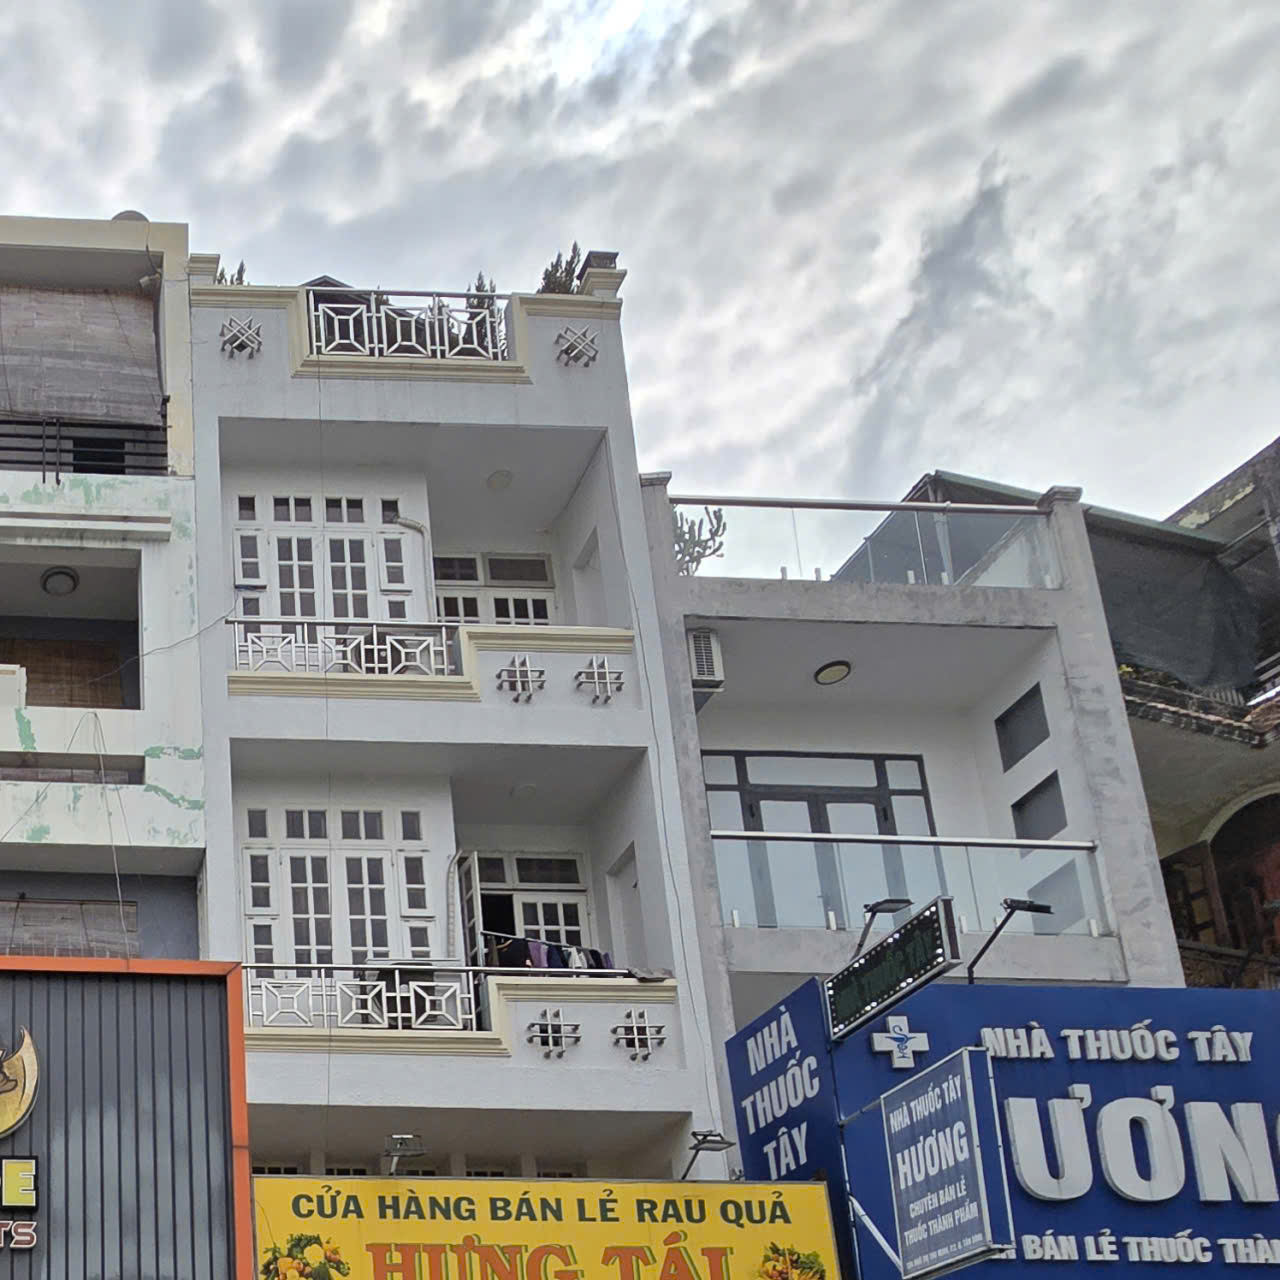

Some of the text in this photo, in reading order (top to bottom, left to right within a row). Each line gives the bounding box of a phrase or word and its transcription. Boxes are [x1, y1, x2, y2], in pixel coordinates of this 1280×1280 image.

[747, 1005, 799, 1076] NHÀ
[980, 1019, 1253, 1062] NHÀ THUỐC TÂY
[742, 1050, 820, 1135] THUỐC
[889, 1074, 962, 1134] NHÀ THUỐC TÂY
[763, 1121, 808, 1180] TÂY
[895, 1120, 970, 1190] HƯƠNG
[1004, 1083, 1280, 1203] ƯƠN
[291, 1184, 792, 1228] CỬA HÀNG BÁN LẺ RAU QUẢ
[1021, 1229, 1079, 1261] BÁN
[1084, 1229, 1119, 1261] LẺ
[1122, 1229, 1212, 1263] THUỐC
